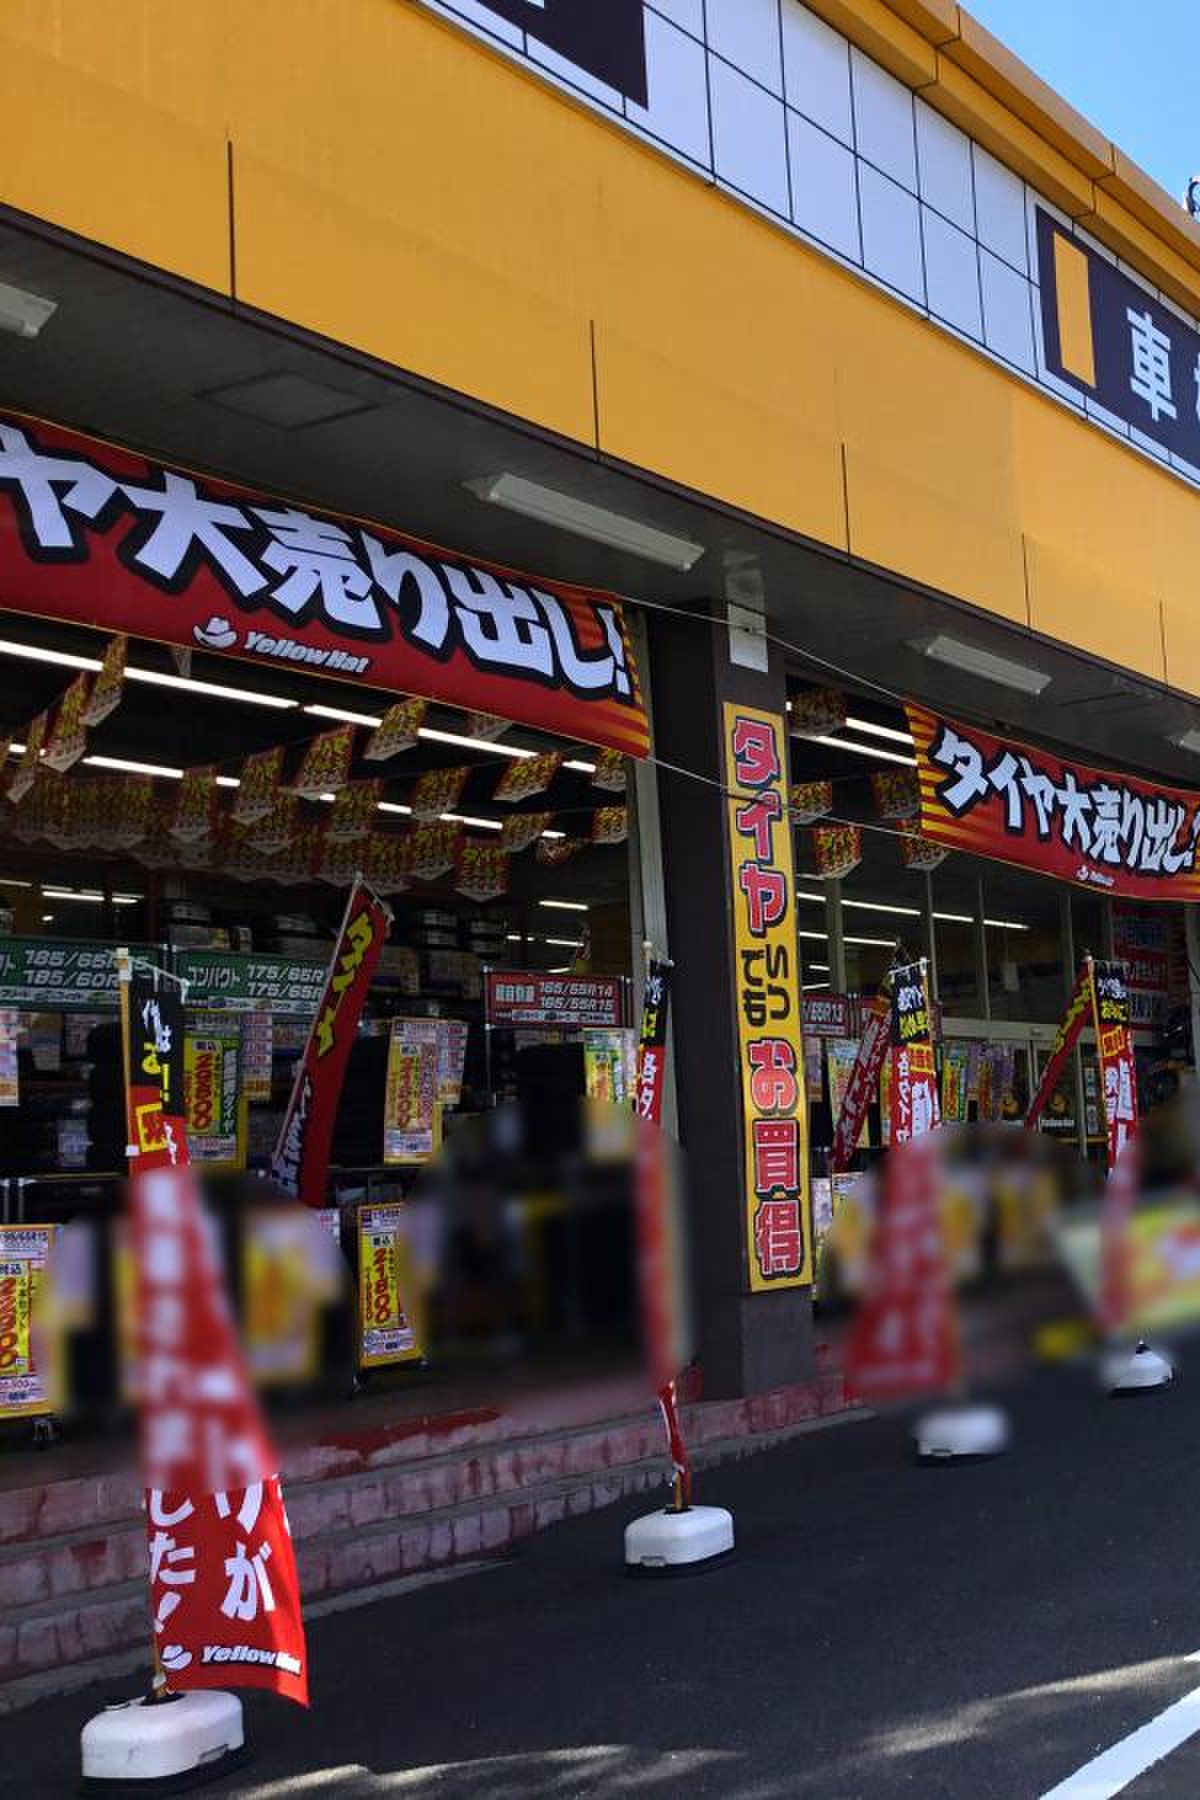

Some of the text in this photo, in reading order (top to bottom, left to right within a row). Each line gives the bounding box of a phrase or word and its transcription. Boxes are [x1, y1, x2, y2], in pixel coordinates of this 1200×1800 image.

[0, 422, 629, 695] ヤ大売り出し!
[736, 720, 785, 932] タイヤ
